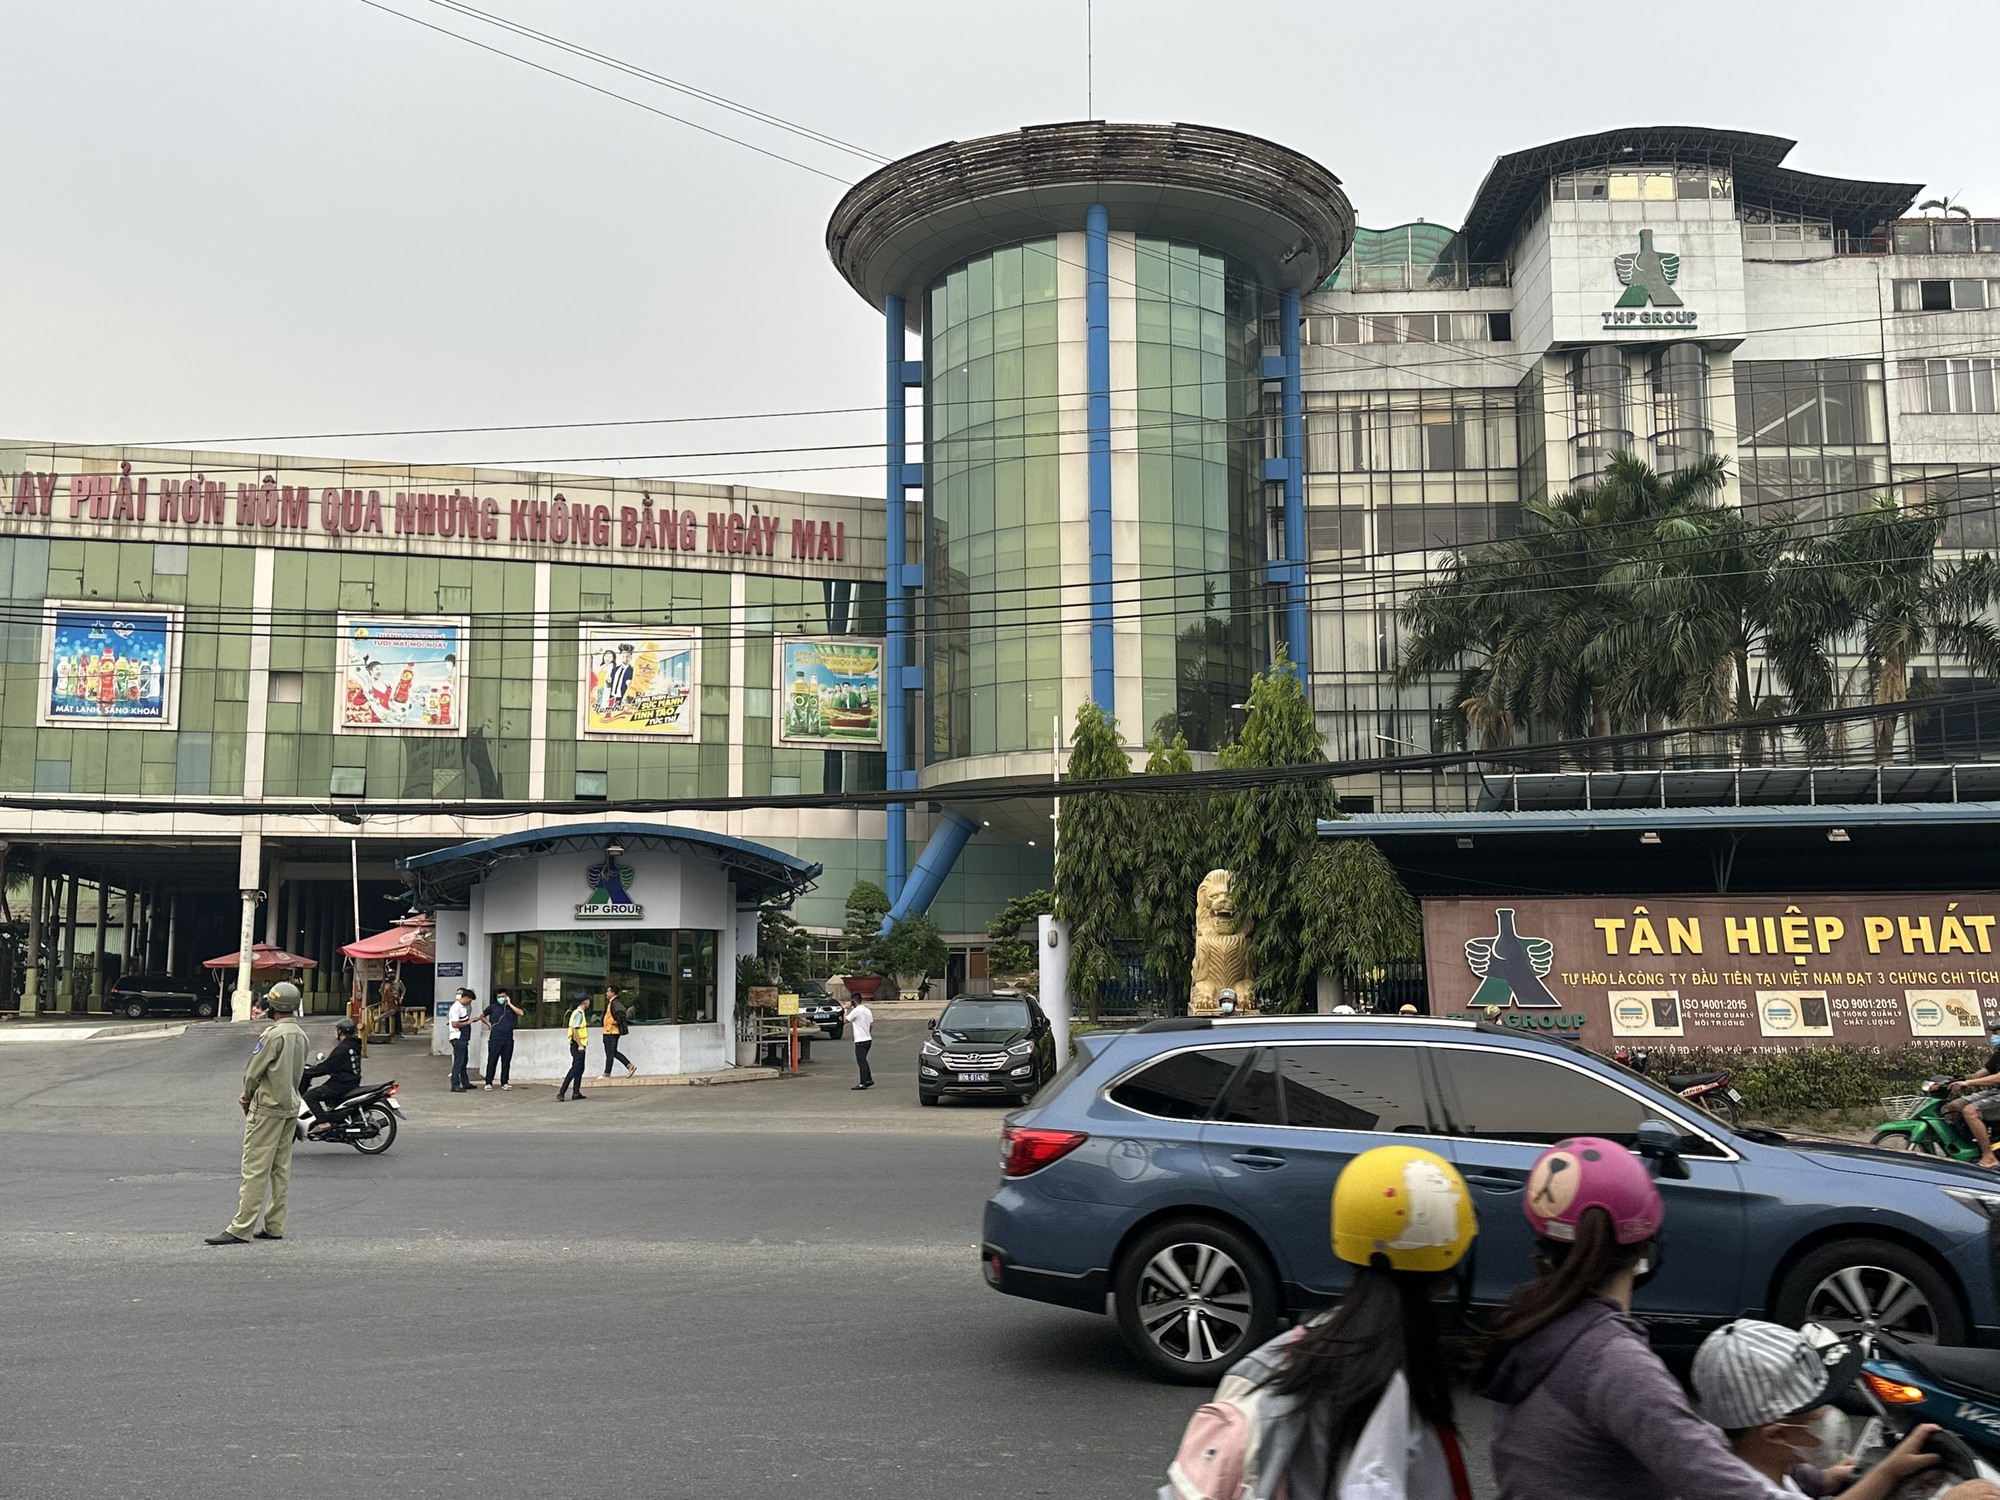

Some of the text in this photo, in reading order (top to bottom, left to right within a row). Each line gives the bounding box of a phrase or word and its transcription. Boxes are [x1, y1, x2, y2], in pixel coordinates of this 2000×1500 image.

[1601, 311, 1697, 324] THP GROUP
[70, 461, 147, 521] PHẢI
[159, 473, 226, 524] HƠN
[236, 475, 309, 529] HÔM
[321, 487, 383, 537] QUA
[395, 488, 499, 540] NHƯNG
[510, 493, 610, 547] KHÔNG
[707, 504, 780, 557] NGÀY
[791, 518, 844, 561] MAI
[578, 904, 642, 914] THP GROUP
[1594, 902, 1996, 965] TÂN HIỆP PHÁT
[1561, 968, 1999, 988] TỰ HÀO LÀ CÔNG TY ĐẦU TIÊN TẠI VIỆT NAM ĐẠT 3 CHỨNG CHỈ TÍCH
[1682, 999, 1747, 1010] ISO 14001:2015
[1832, 998, 1898, 1009] ISO 9001:2015
[1983, 998, 1997, 1008] ISO
[1504, 1012, 1587, 1029] GROUP
